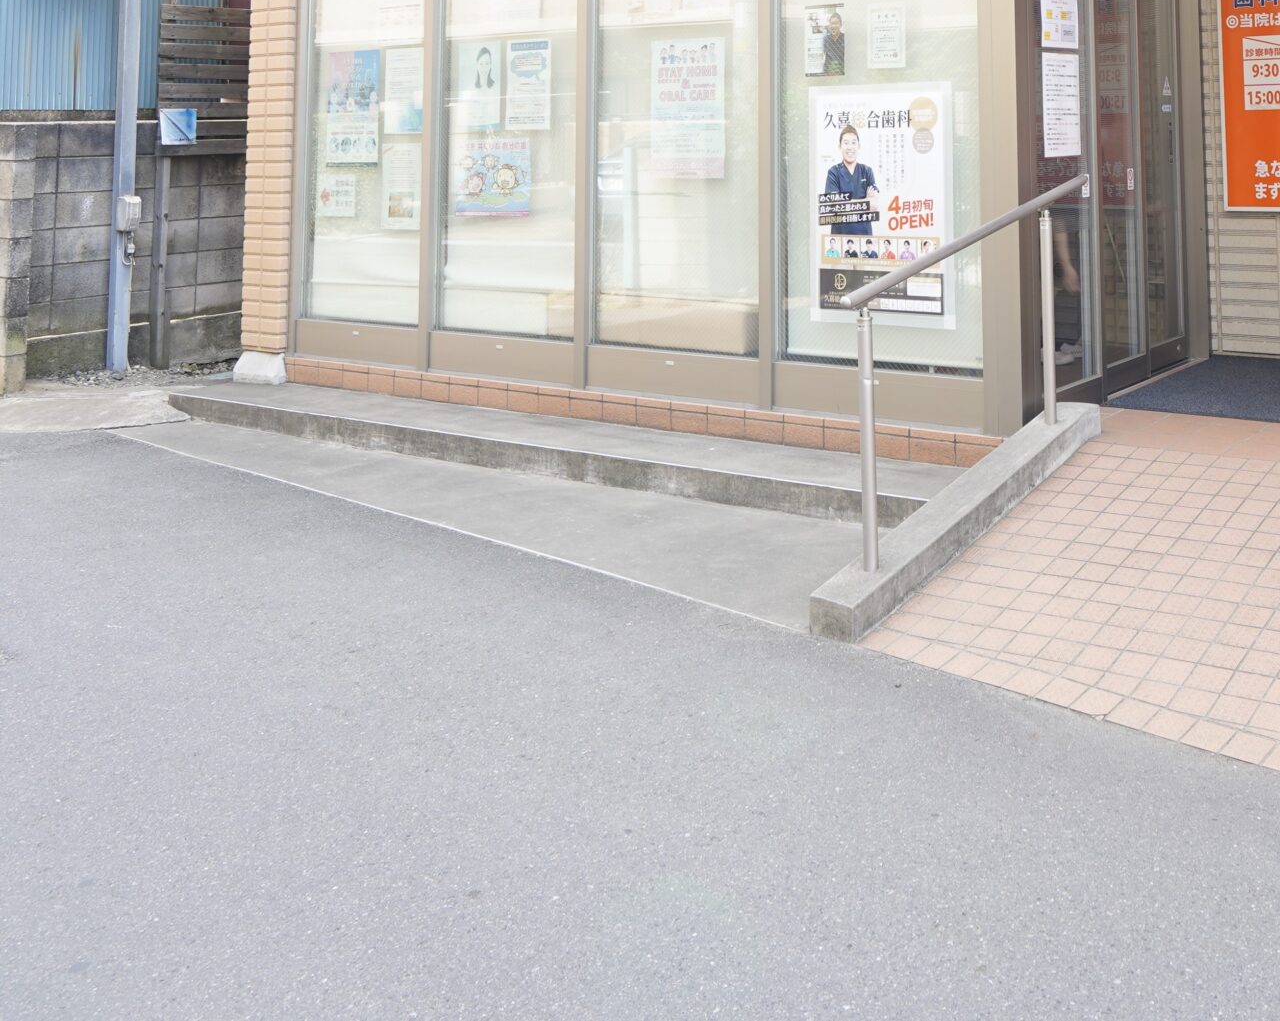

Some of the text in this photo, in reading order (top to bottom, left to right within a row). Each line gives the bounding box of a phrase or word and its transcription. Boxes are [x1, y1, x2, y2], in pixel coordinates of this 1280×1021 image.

[658, 65, 717, 78] STAY HOME
[824, 110, 912, 129] 久喜総合歯科
[888, 195, 933, 215] 4月初旬
[888, 212, 934, 231] OPEN!
